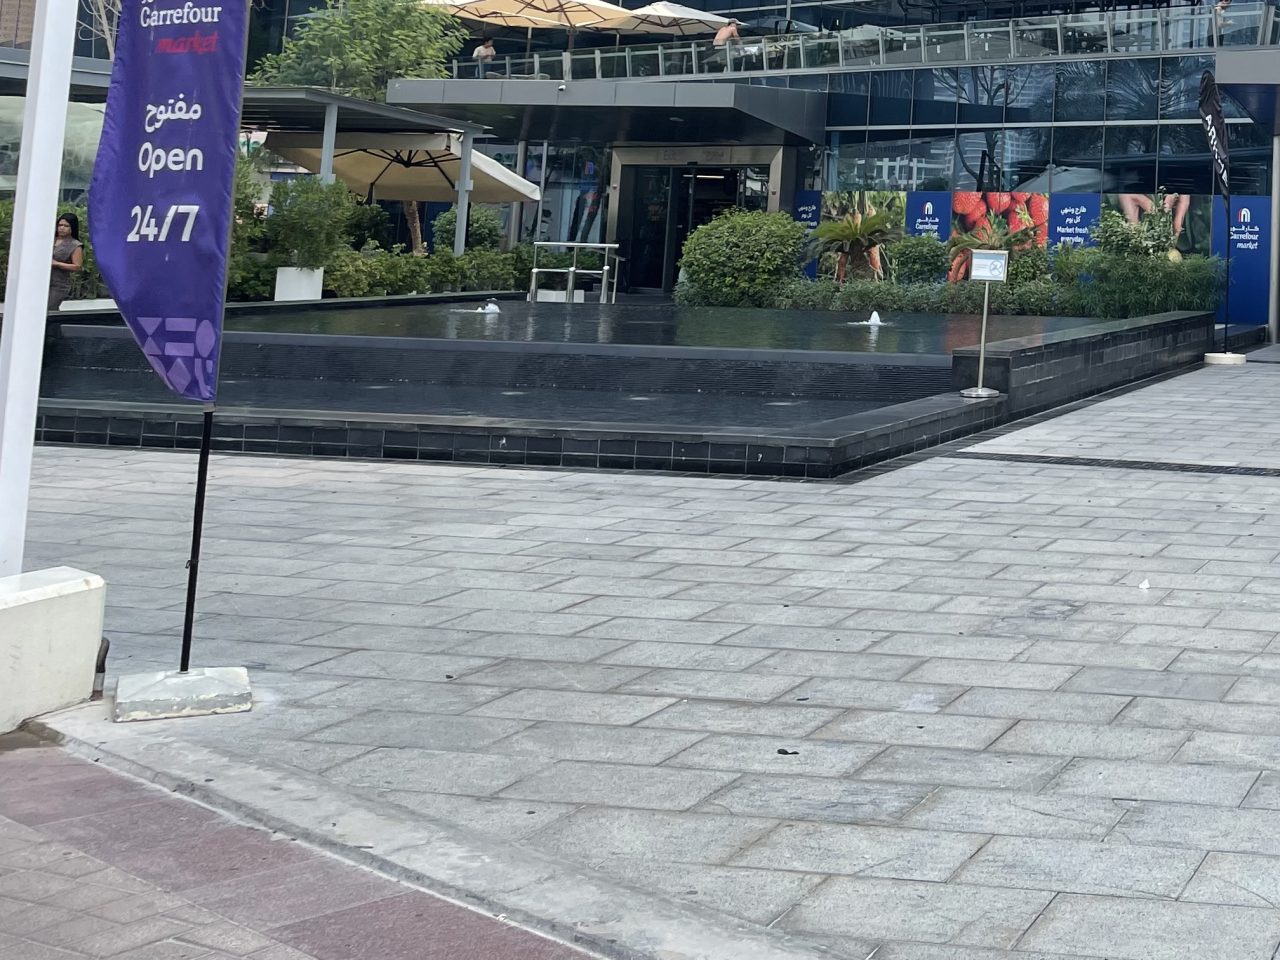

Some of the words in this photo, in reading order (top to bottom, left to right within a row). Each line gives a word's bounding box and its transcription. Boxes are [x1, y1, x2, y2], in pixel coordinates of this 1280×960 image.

[140, 1, 222, 27] Carrefour
[155, 30, 219, 54] market
[145, 93, 202, 133] مفتوح
[138, 142, 203, 179] Open
[126, 205, 200, 242] 24/7
[1056, 226, 1075, 234] Market
[1075, 226, 1089, 234] fresh
[1236, 241, 1259, 250] market
